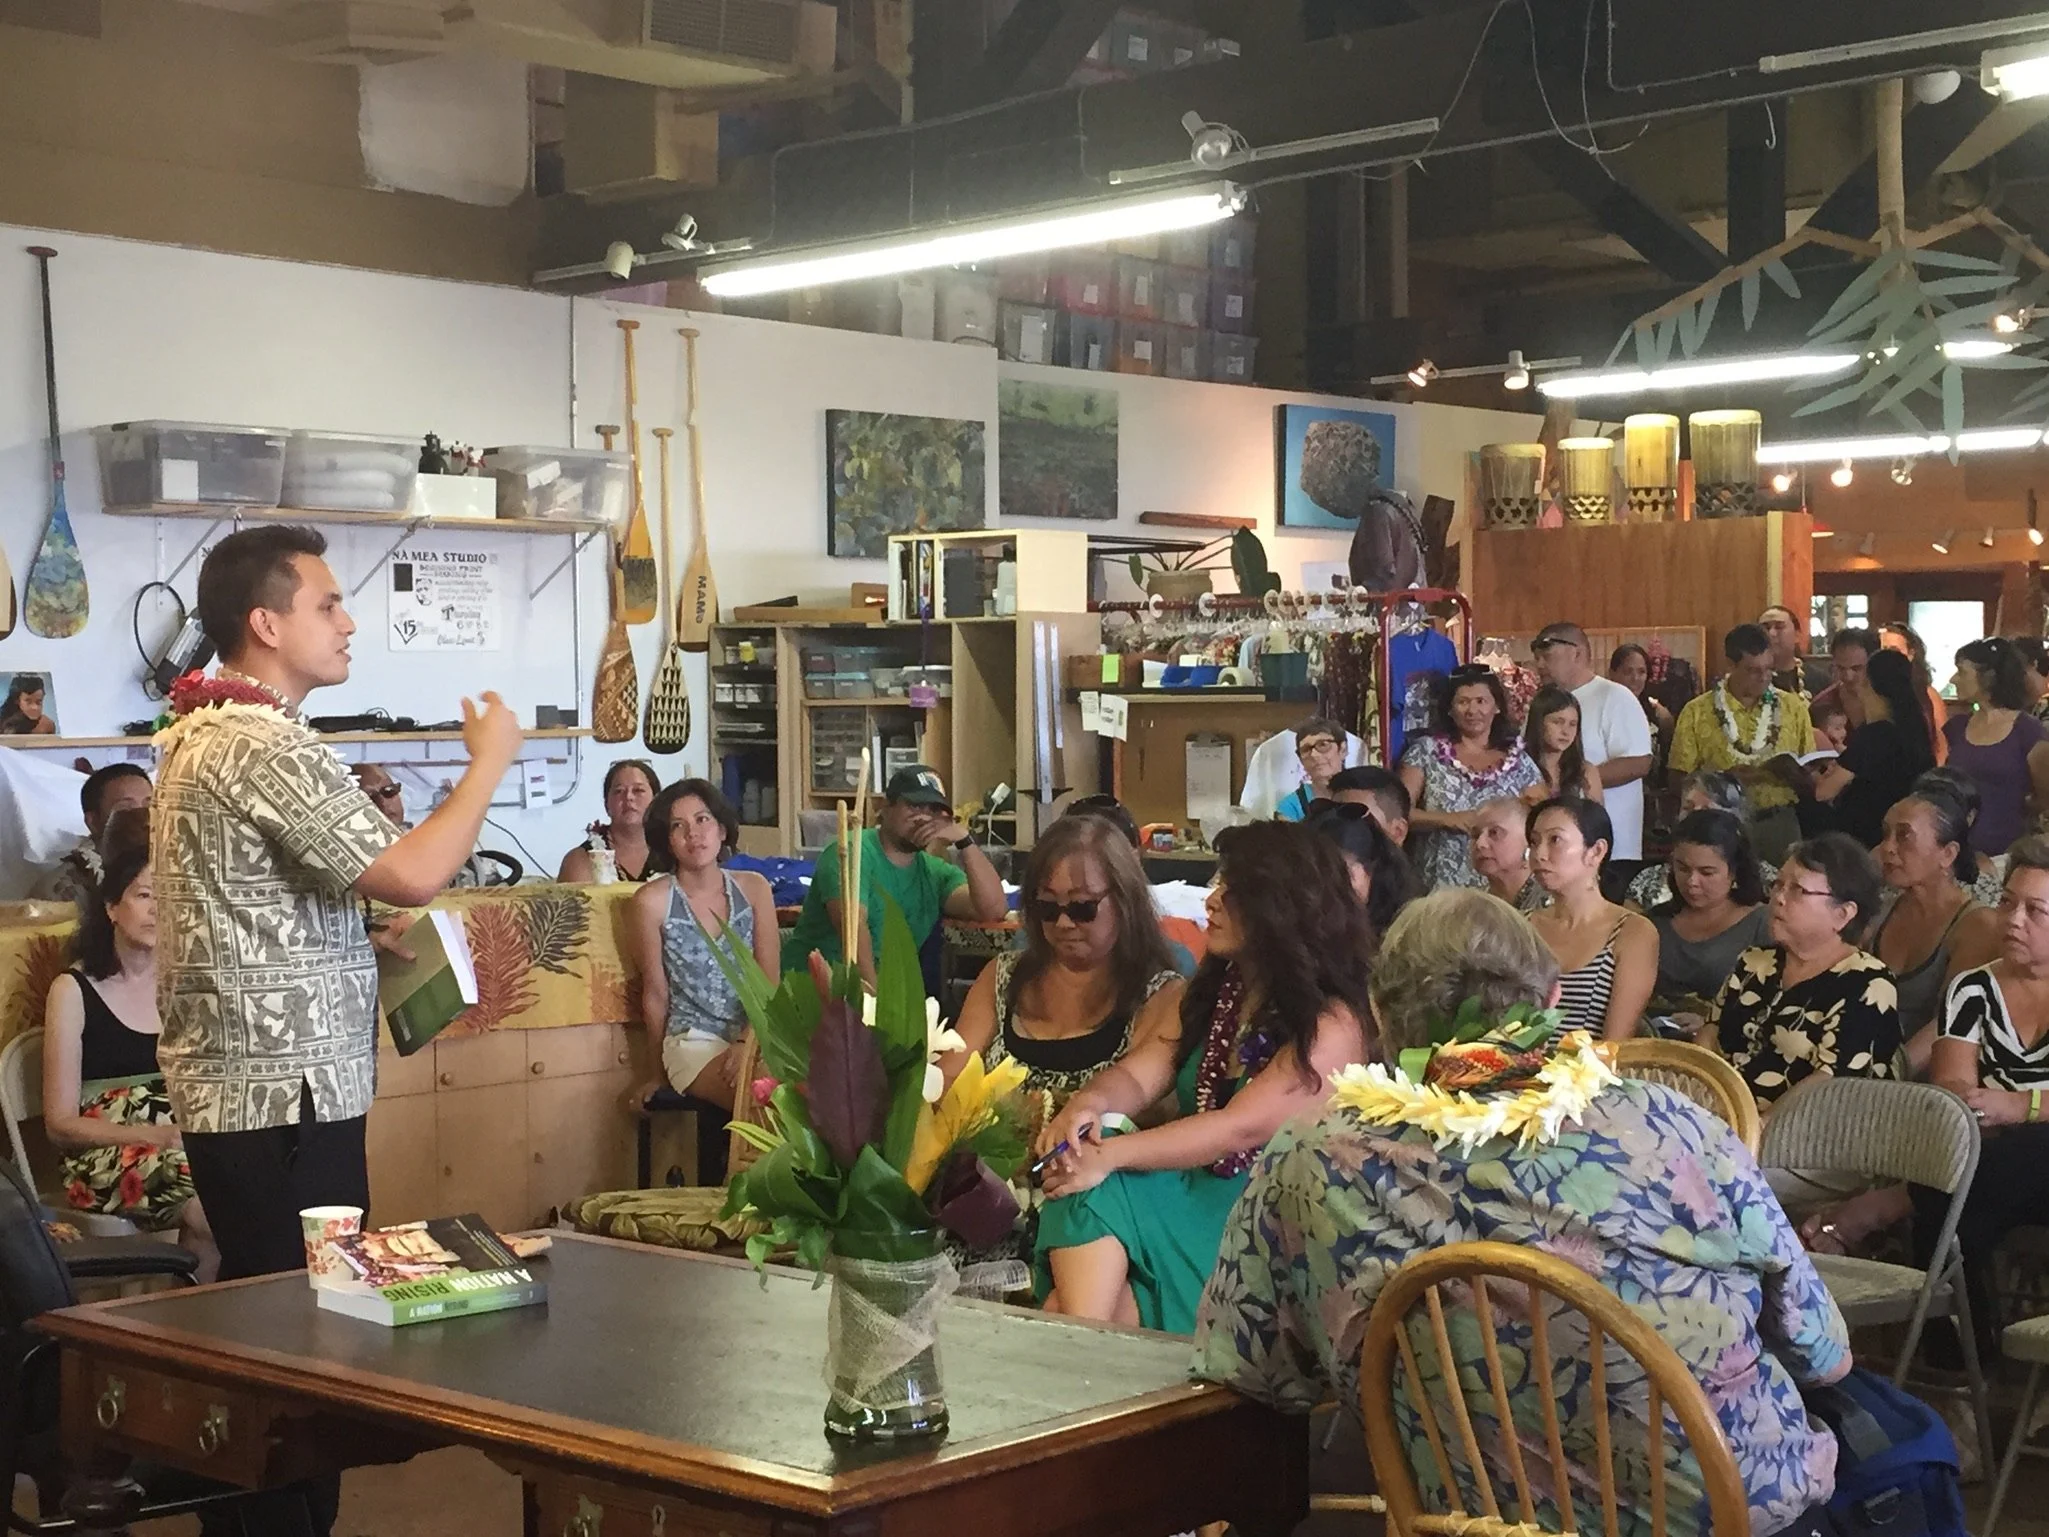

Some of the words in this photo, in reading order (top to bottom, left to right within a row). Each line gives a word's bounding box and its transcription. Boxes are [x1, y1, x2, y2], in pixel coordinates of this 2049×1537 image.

[411, 551, 438, 562] MEA
[443, 553, 487, 563] STUDIO
[450, 1271, 517, 1291] NATION
[514, 1268, 533, 1282] A
[383, 1282, 450, 1301] RISING
